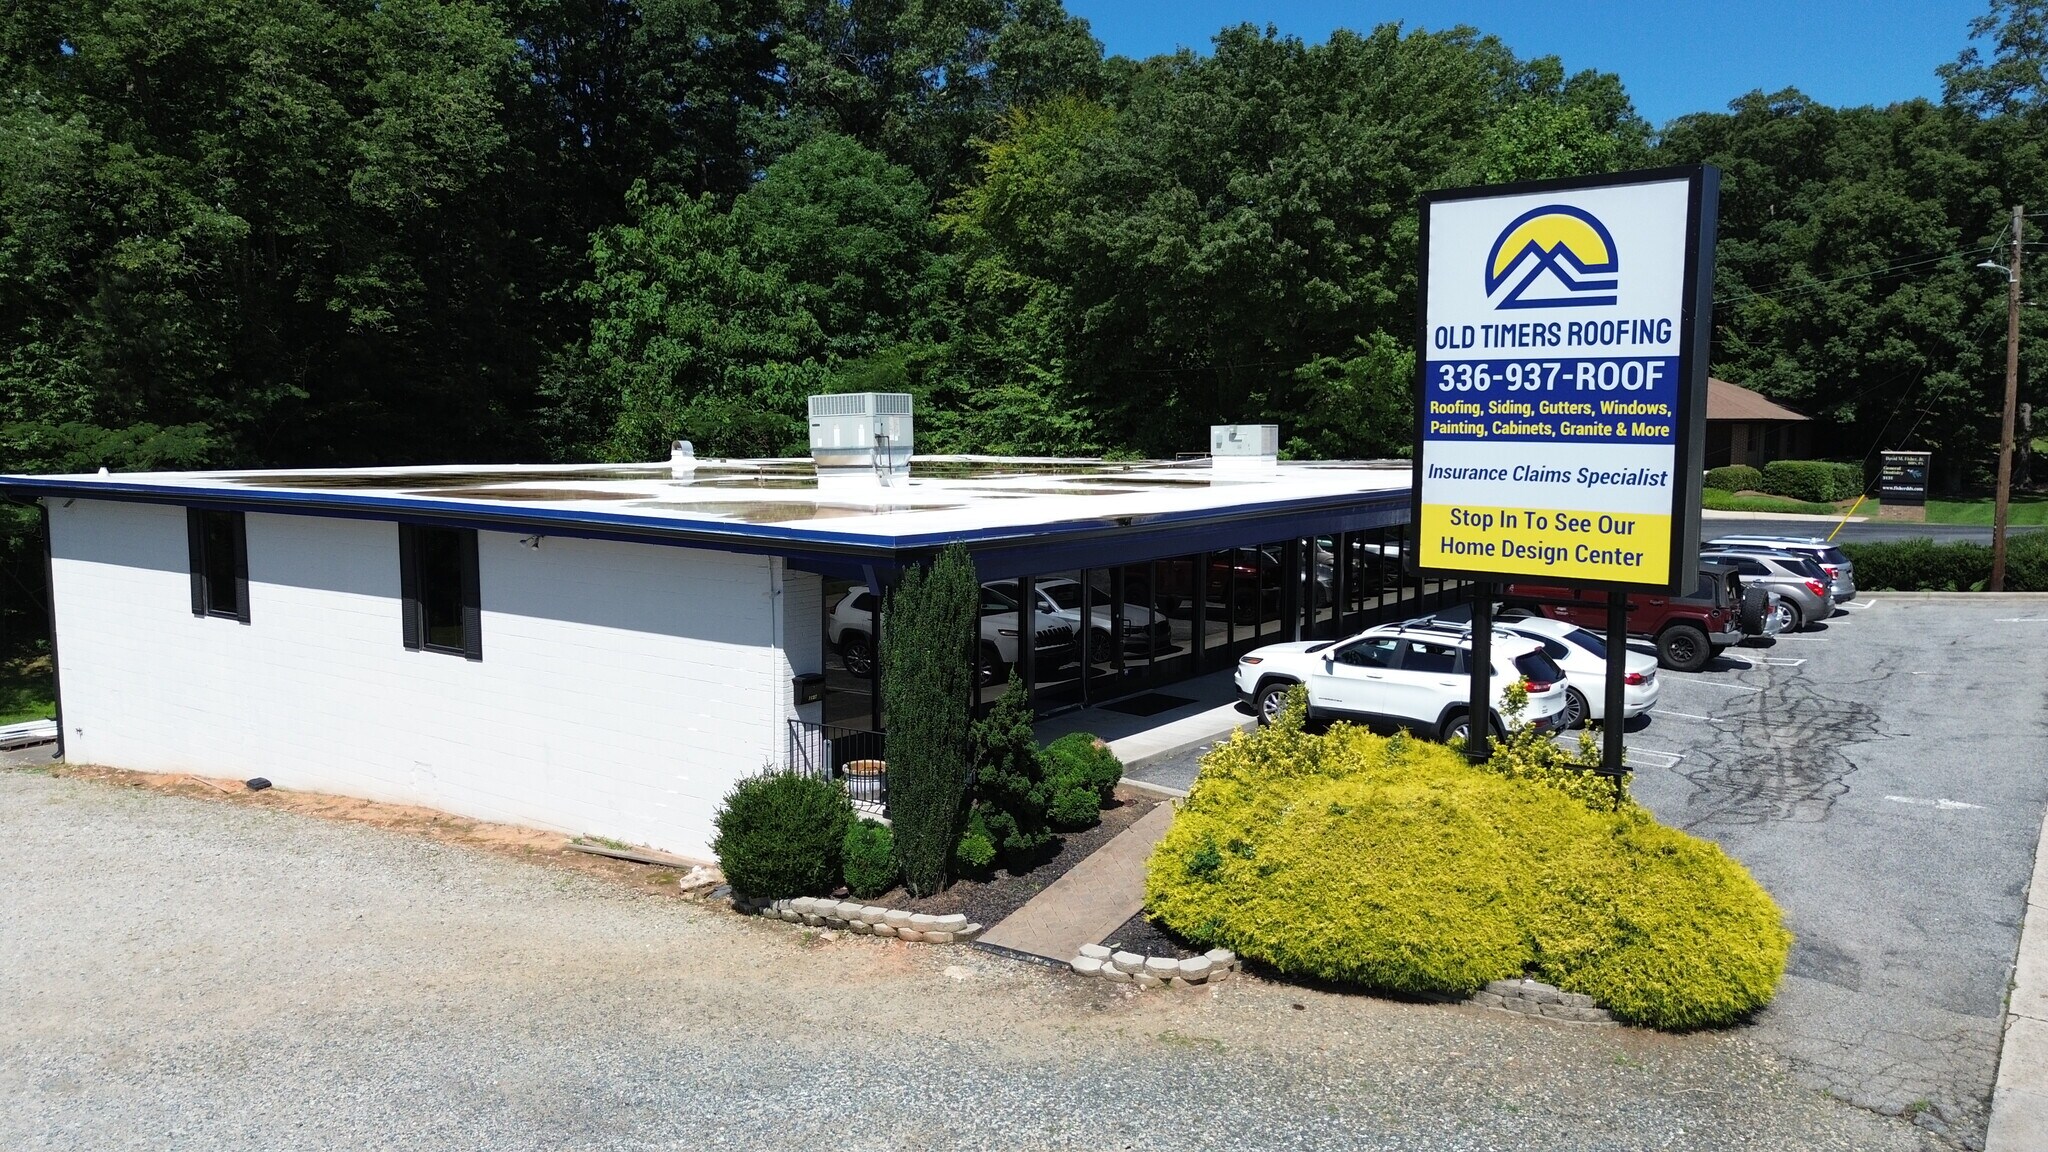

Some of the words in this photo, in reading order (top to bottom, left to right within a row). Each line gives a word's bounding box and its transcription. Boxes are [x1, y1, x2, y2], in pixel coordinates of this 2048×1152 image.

[1435, 325, 1475, 349] OLD
[1481, 322, 1561, 348] TIMERS
[1567, 318, 1672, 346] ROOFING
[1438, 361, 1665, 391] 336-937-ROOF
[1430, 400, 1484, 417] Roofing,
[1488, 400, 1535, 417] Siding,
[1539, 400, 1595, 417] Gutters,
[1600, 400, 1672, 417] Windows,
[1430, 421, 1488, 438] Painting,
[1492, 421, 1556, 437] Cabinets,
[1560, 421, 1612, 436] Granite
[1616, 422, 1627, 436] &
[1631, 422, 1670, 437] More
[1428, 464, 1508, 481] Insurance
[1512, 465, 1571, 483] Claims
[1576, 467, 1668, 488] Specialist
[1450, 508, 1493, 531] Stop
[1500, 510, 1517, 529] In
[1524, 511, 1548, 530] To
[1554, 513, 1591, 533] See
[1598, 515, 1635, 535] Our
[1440, 536, 1495, 557] Home
[1502, 539, 1568, 565] Design
[1575, 544, 1643, 567] Center
